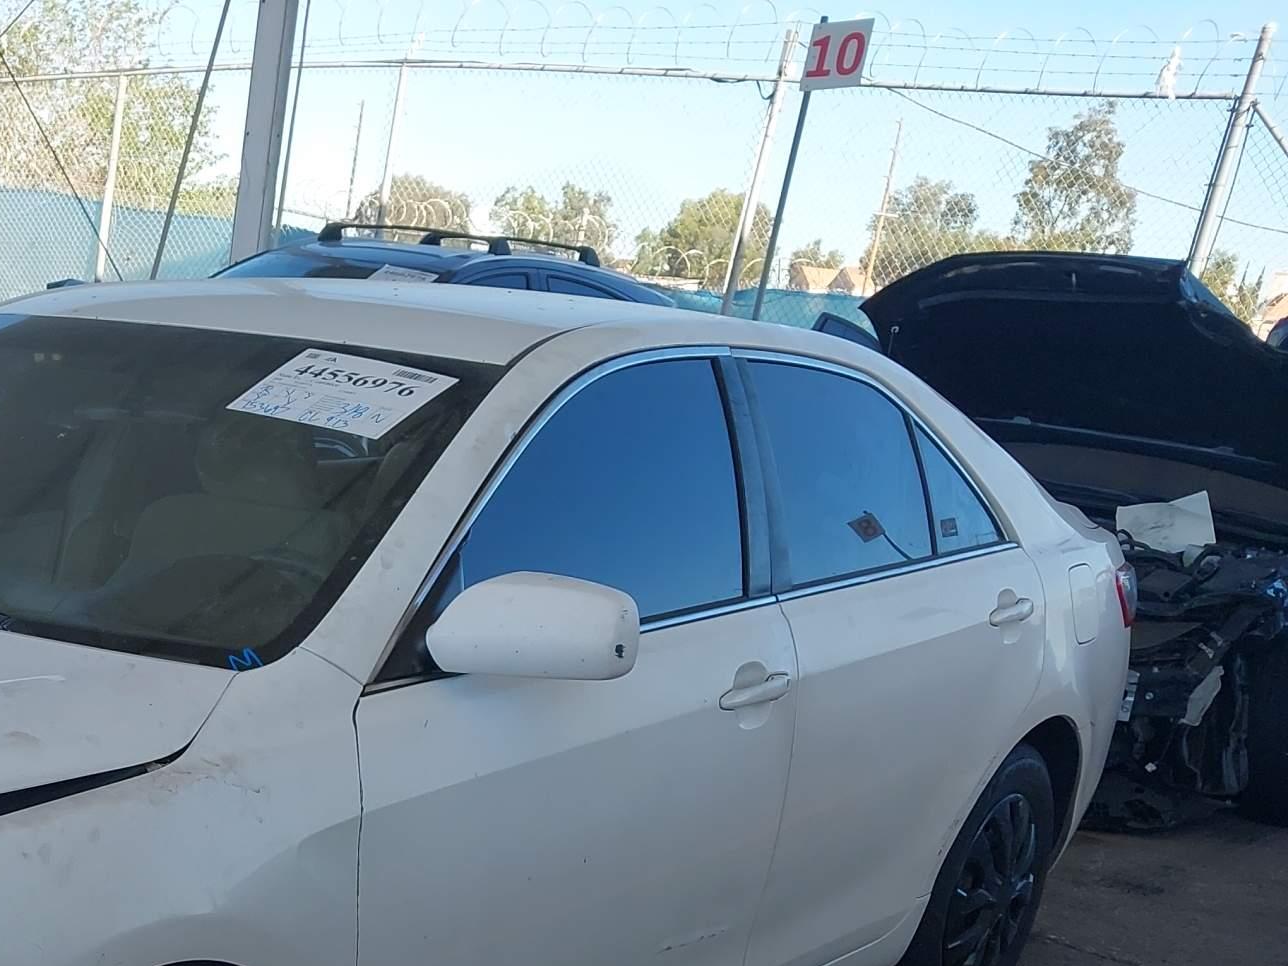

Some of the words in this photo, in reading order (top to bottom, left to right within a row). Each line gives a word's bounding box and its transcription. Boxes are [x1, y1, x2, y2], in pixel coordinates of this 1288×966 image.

[805, 31, 866, 78] 10
[294, 364, 422, 397] 44556976
[228, 647, 264, 671] M
